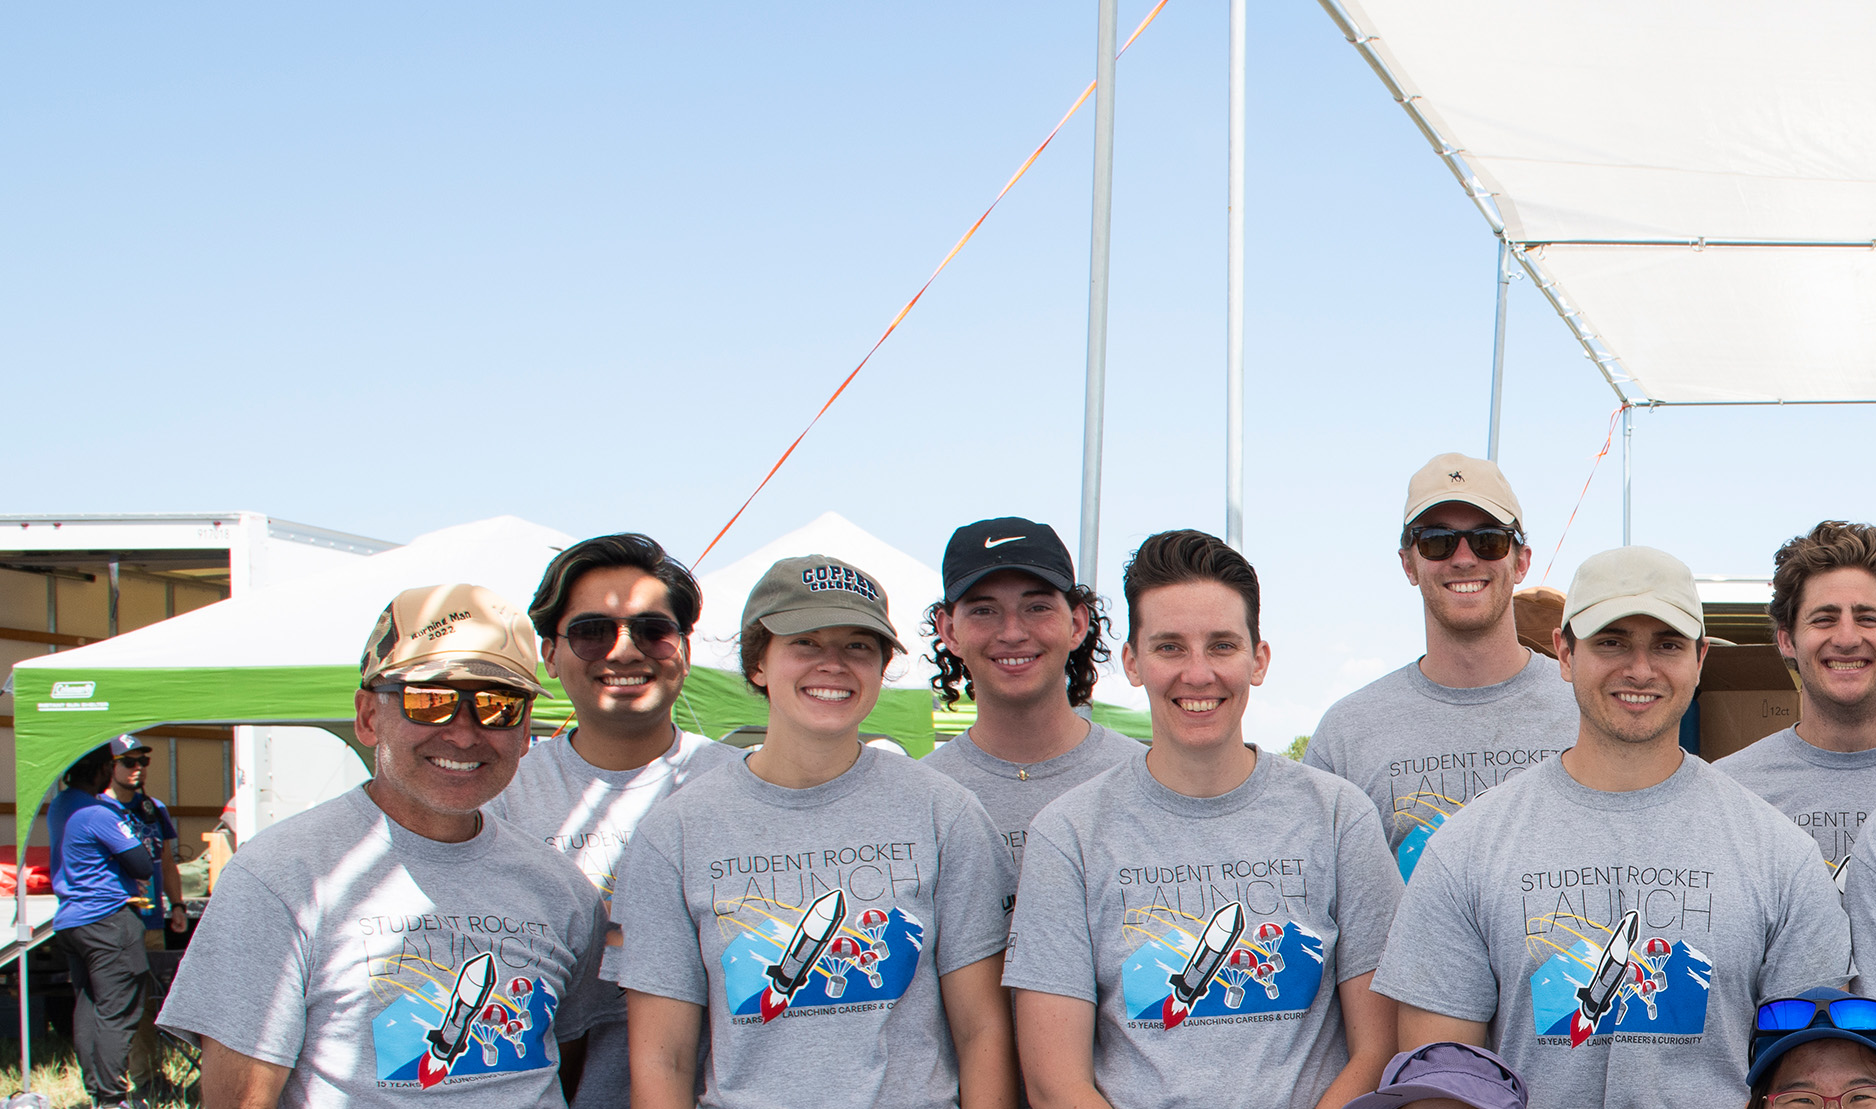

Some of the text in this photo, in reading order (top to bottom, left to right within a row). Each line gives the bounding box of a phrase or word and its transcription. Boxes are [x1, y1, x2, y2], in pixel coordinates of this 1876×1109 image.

[802, 565, 880, 598] COPPER
[810, 580, 876, 602] COLORADO
[449, 610, 472, 623] Man
[428, 625, 456, 641] 2022
[1770, 706, 1790, 717] 12ct
[1390, 749, 1560, 777] STUDENT ROCKE
[1793, 811, 1850, 828] DENT
[545, 831, 632, 851] STUDENT
[710, 842, 917, 880] STUDENT ROCKET
[1119, 858, 1305, 885] STUDENT ROCKET
[1521, 865, 1714, 891] STUDENT ROCKET
[712, 863, 921, 917] LAUNCH
[1121, 878, 1310, 925] LAUNCH
[1522, 889, 1712, 936] LAUNCH
[359, 914, 549, 938] STUDENT ROCKET
[364, 932, 562, 977] LAUNCH
[782, 1007, 837, 1019] LAUNCHING
[838, 1002, 877, 1014] CAREERS
[1183, 1017, 1234, 1027] LAUNCHING
[1236, 1014, 1274, 1024] CAREERS
[1275, 1013, 1282, 1021] &
[738, 1016, 764, 1026] YEARS
[1127, 1021, 1165, 1029] 15 YEARS
[1547, 1037, 1572, 1047] YEARS
[1586, 1036, 1614, 1047] LAUNC
[1615, 1034, 1651, 1044] CAREERS
[1658, 1035, 1703, 1045] CURIOSITY
[376, 1080, 423, 1089] 15 YEARS
